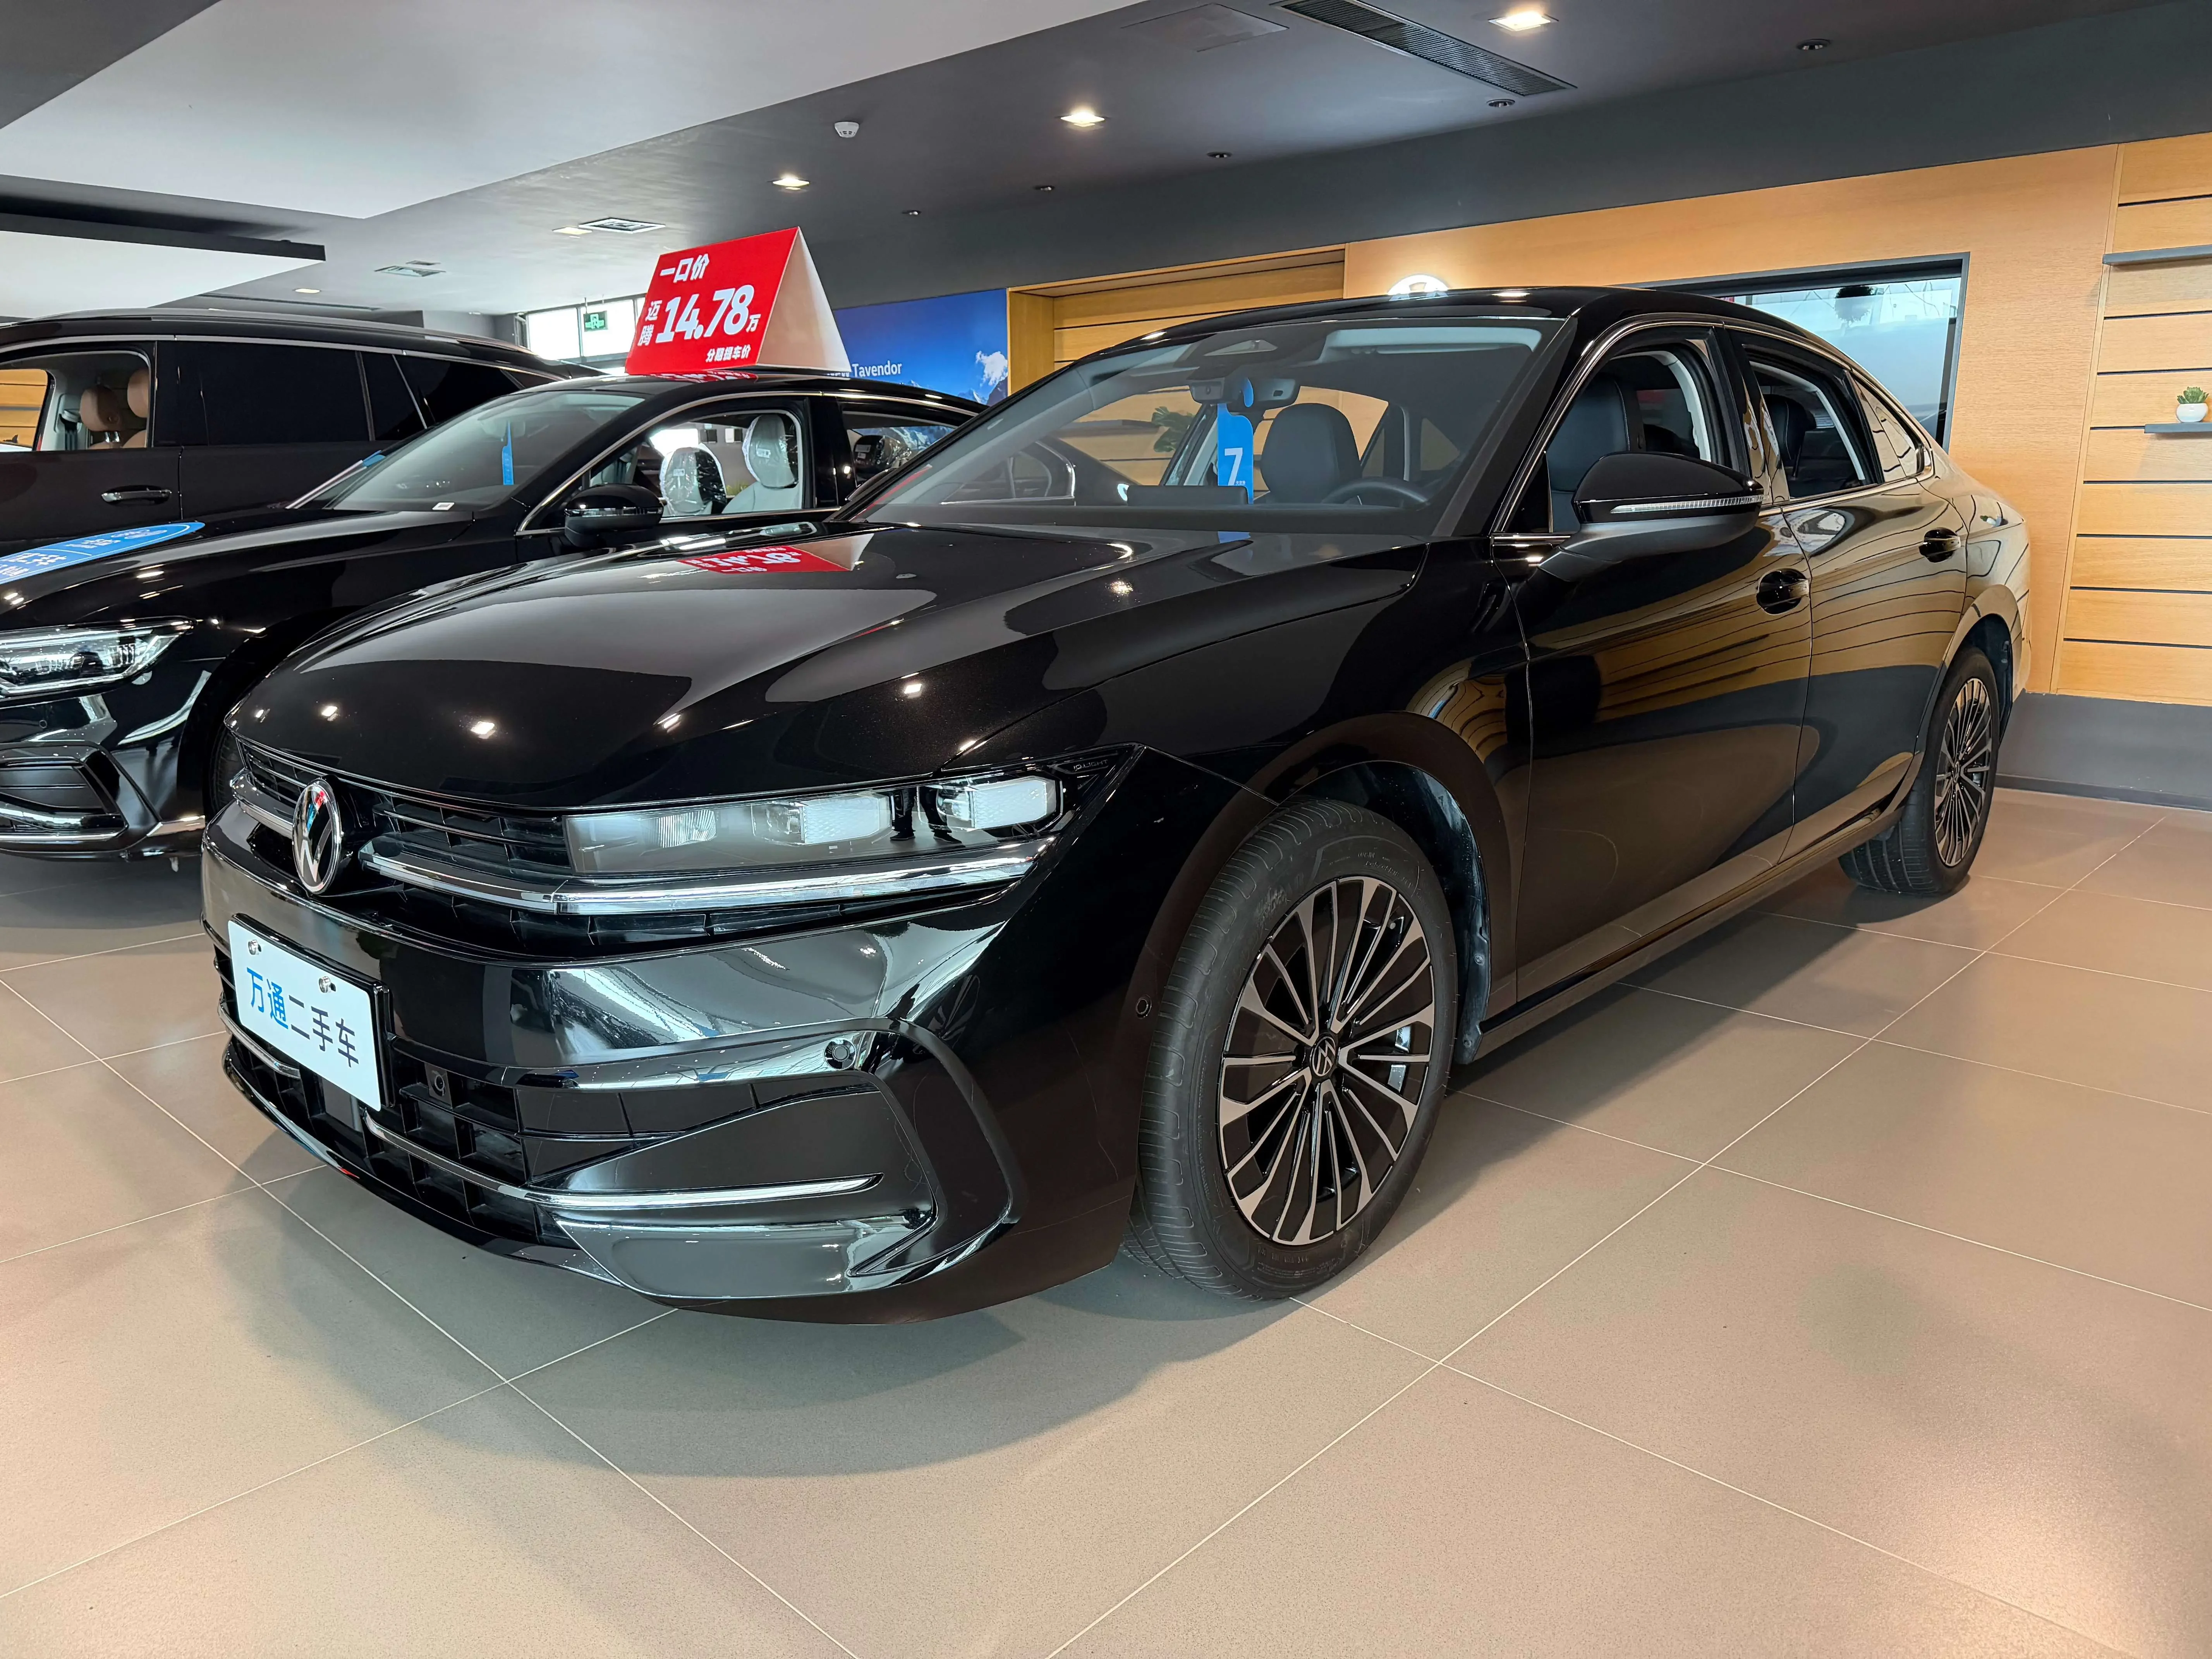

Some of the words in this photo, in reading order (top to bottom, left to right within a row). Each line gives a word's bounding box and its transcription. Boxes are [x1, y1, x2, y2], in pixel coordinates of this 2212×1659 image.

[659, 254, 709, 283] 一口价
[637, 300, 663, 346] 迈腾
[852, 360, 902, 378] Tavendor
[1224, 447, 1243, 486] 7
[1073, 759, 1108, 771] IQ.LIGHT
[246, 967, 359, 1068] 万通二手车
